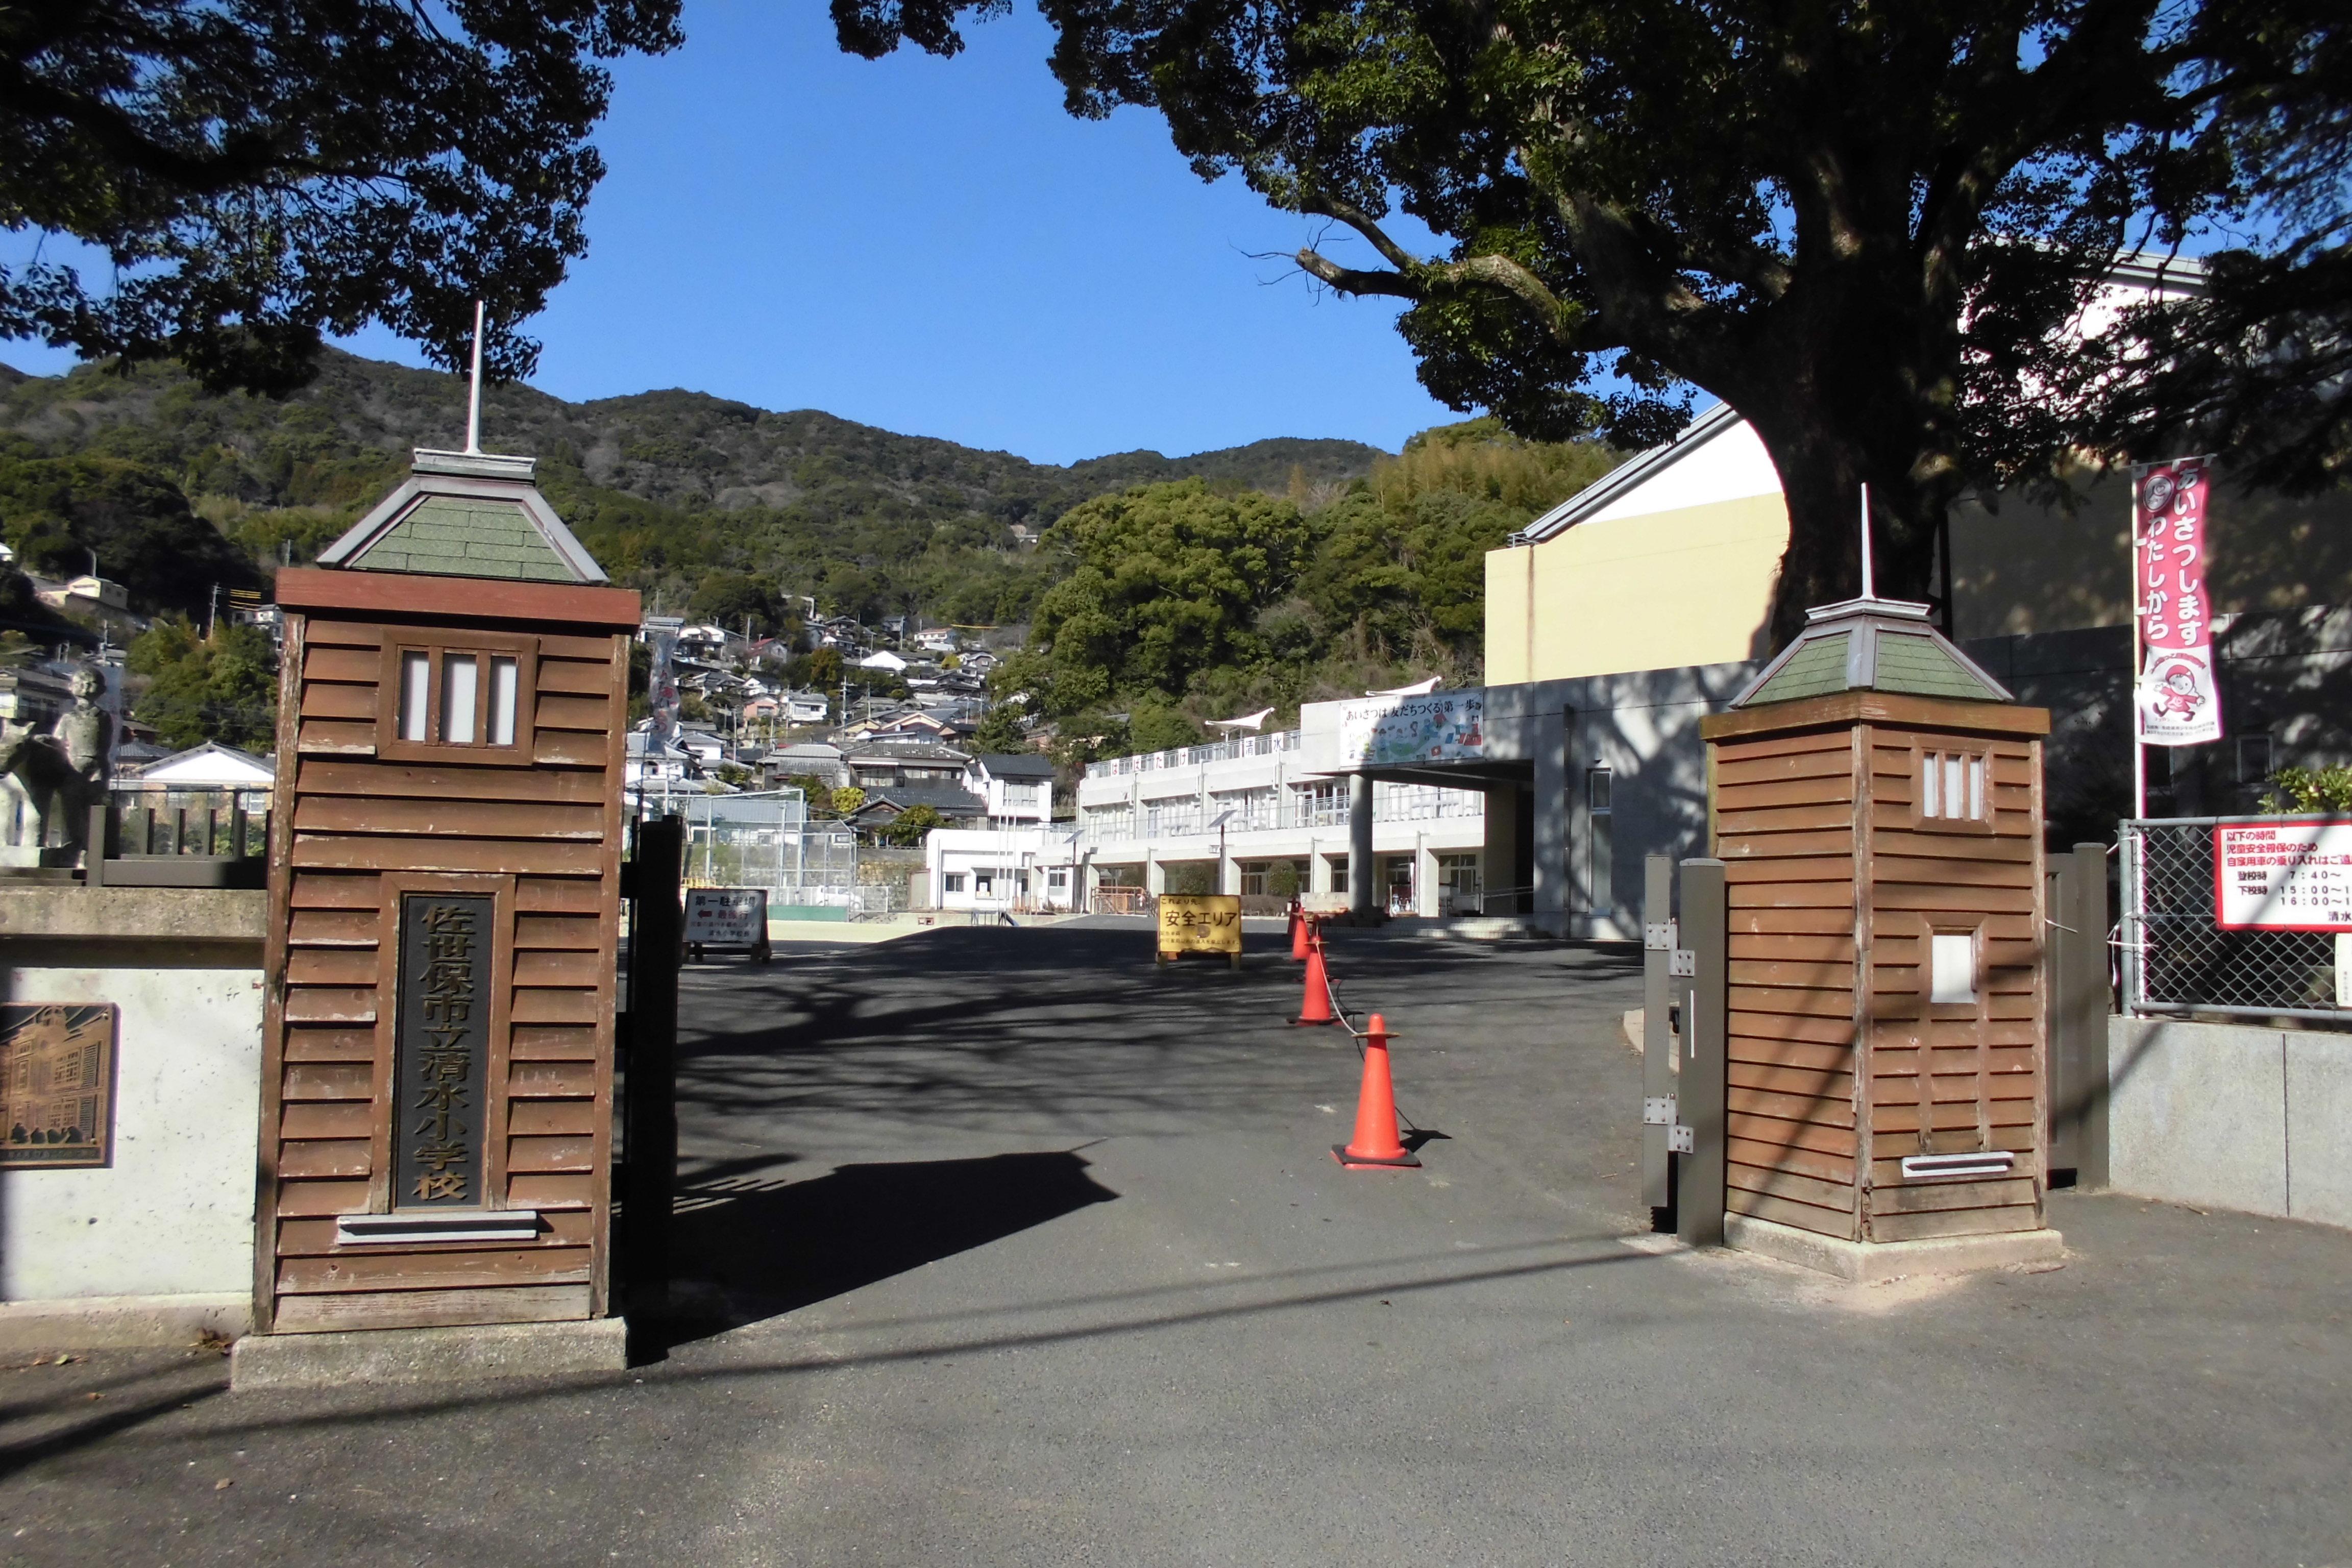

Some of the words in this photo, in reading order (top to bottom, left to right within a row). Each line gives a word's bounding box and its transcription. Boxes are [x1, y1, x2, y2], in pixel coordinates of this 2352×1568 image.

[2171, 468, 2202, 646] あいさつします
[2146, 515, 2169, 641] わたしから
[2226, 830, 2275, 841] 以下の時間
[2226, 842, 2318, 854] 児童安全確保のため
[2227, 854, 2352, 867] 自家用車の乗り入れはご遠
[2238, 886, 2268, 895] 下校時
[695, 895, 756, 907] 第一駐車場
[1165, 910, 1238, 927] 安全エリア
[2328, 912, 2351, 921] 清水
[411, 903, 477, 1200] 佐世保市立清水小学校
